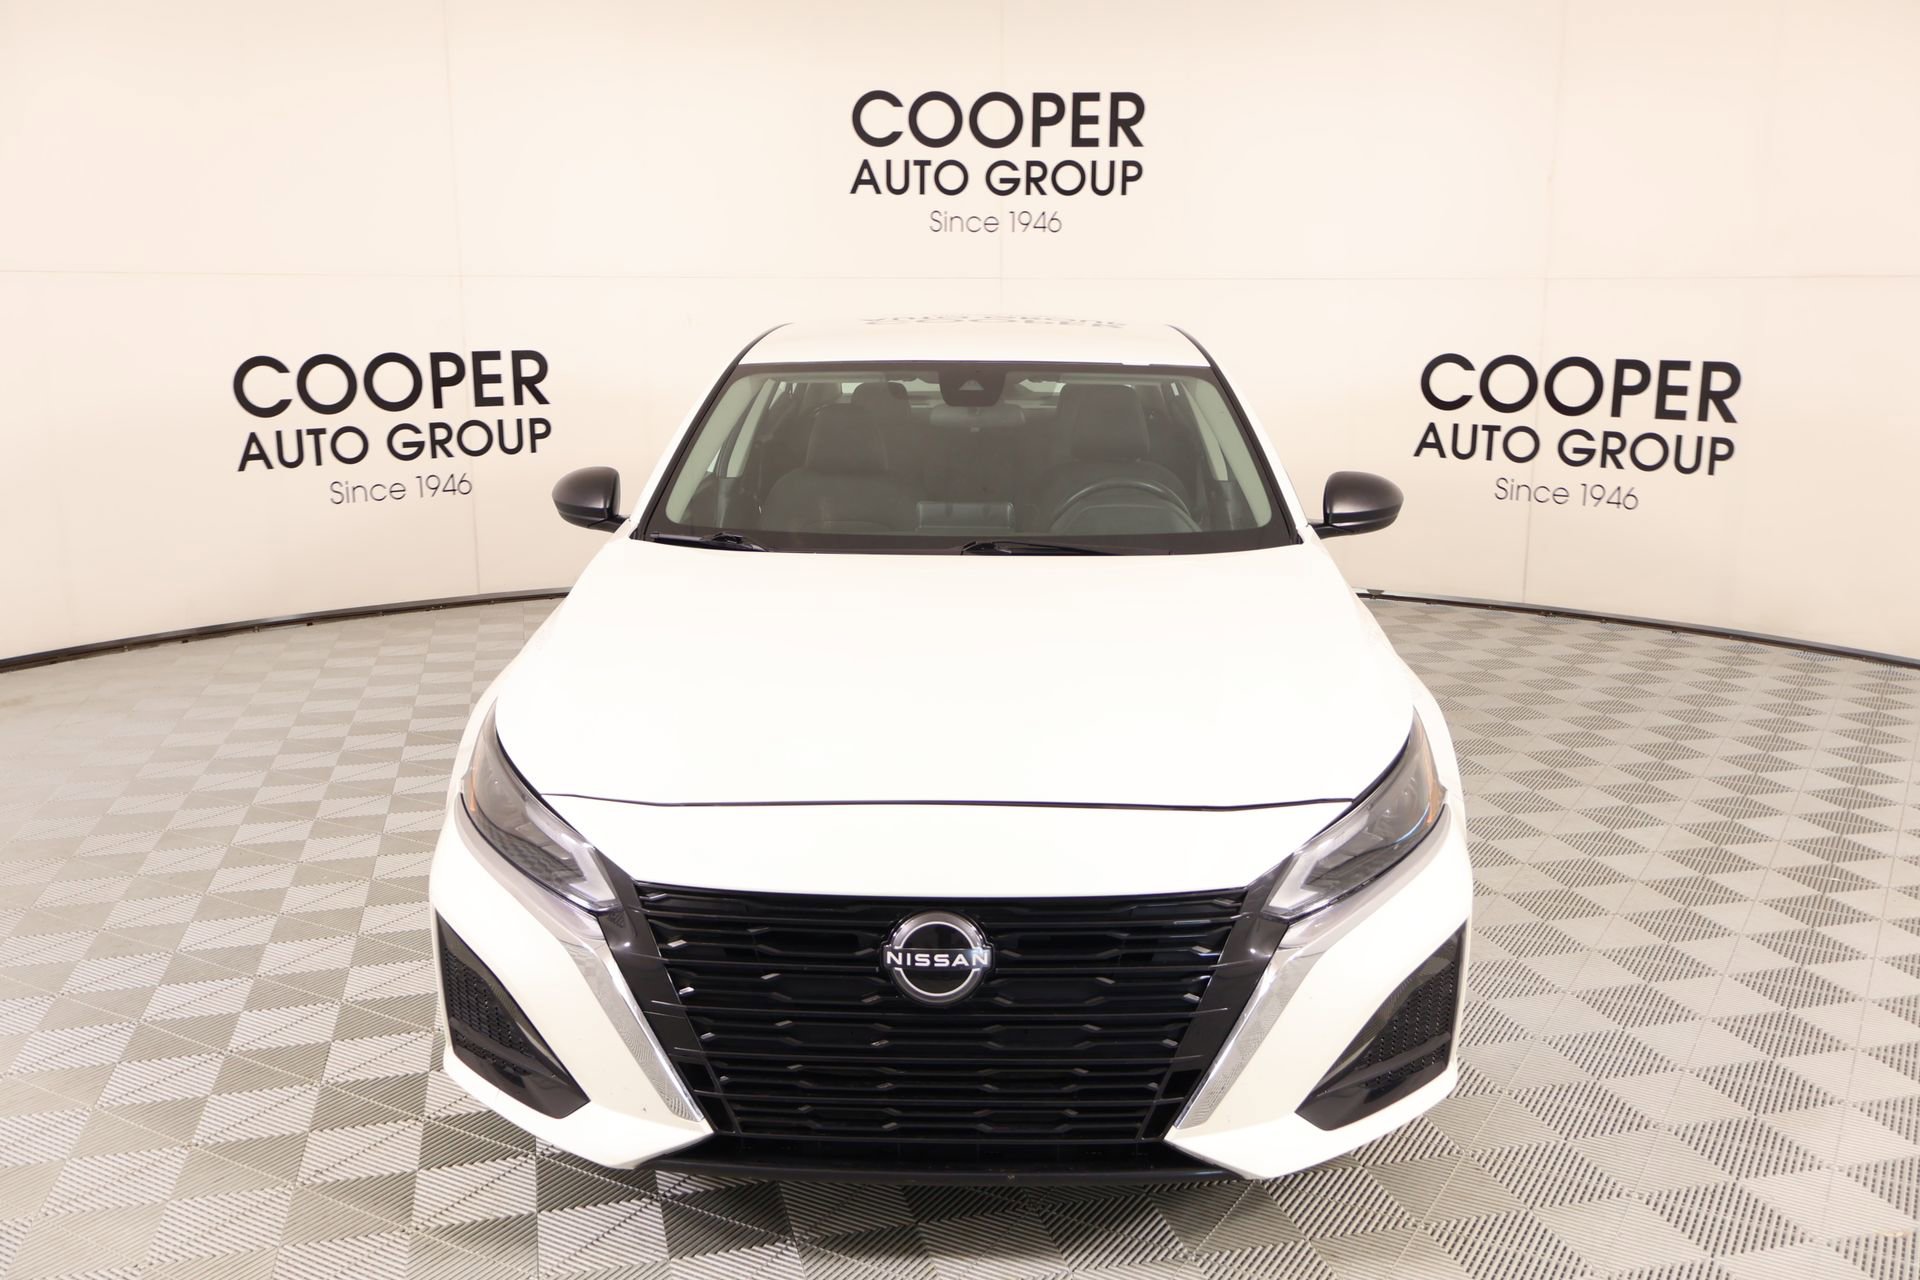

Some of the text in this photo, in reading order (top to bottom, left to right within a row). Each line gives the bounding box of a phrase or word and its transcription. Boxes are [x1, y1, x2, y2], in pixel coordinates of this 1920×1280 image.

[851, 89, 1146, 149] COOPER
[849, 158, 1144, 197] AUTO GROUP
[929, 209, 1063, 234] Since 1946
[232, 349, 552, 419] COOPER
[1419, 352, 1743, 425] COOPER
[236, 416, 553, 473] AUTO GROUP
[1412, 421, 1736, 477] AUTO GROUP
[329, 472, 473, 505] Since 1946
[1494, 476, 1639, 511] Since 1946
[886, 950, 989, 967] NISSAN
